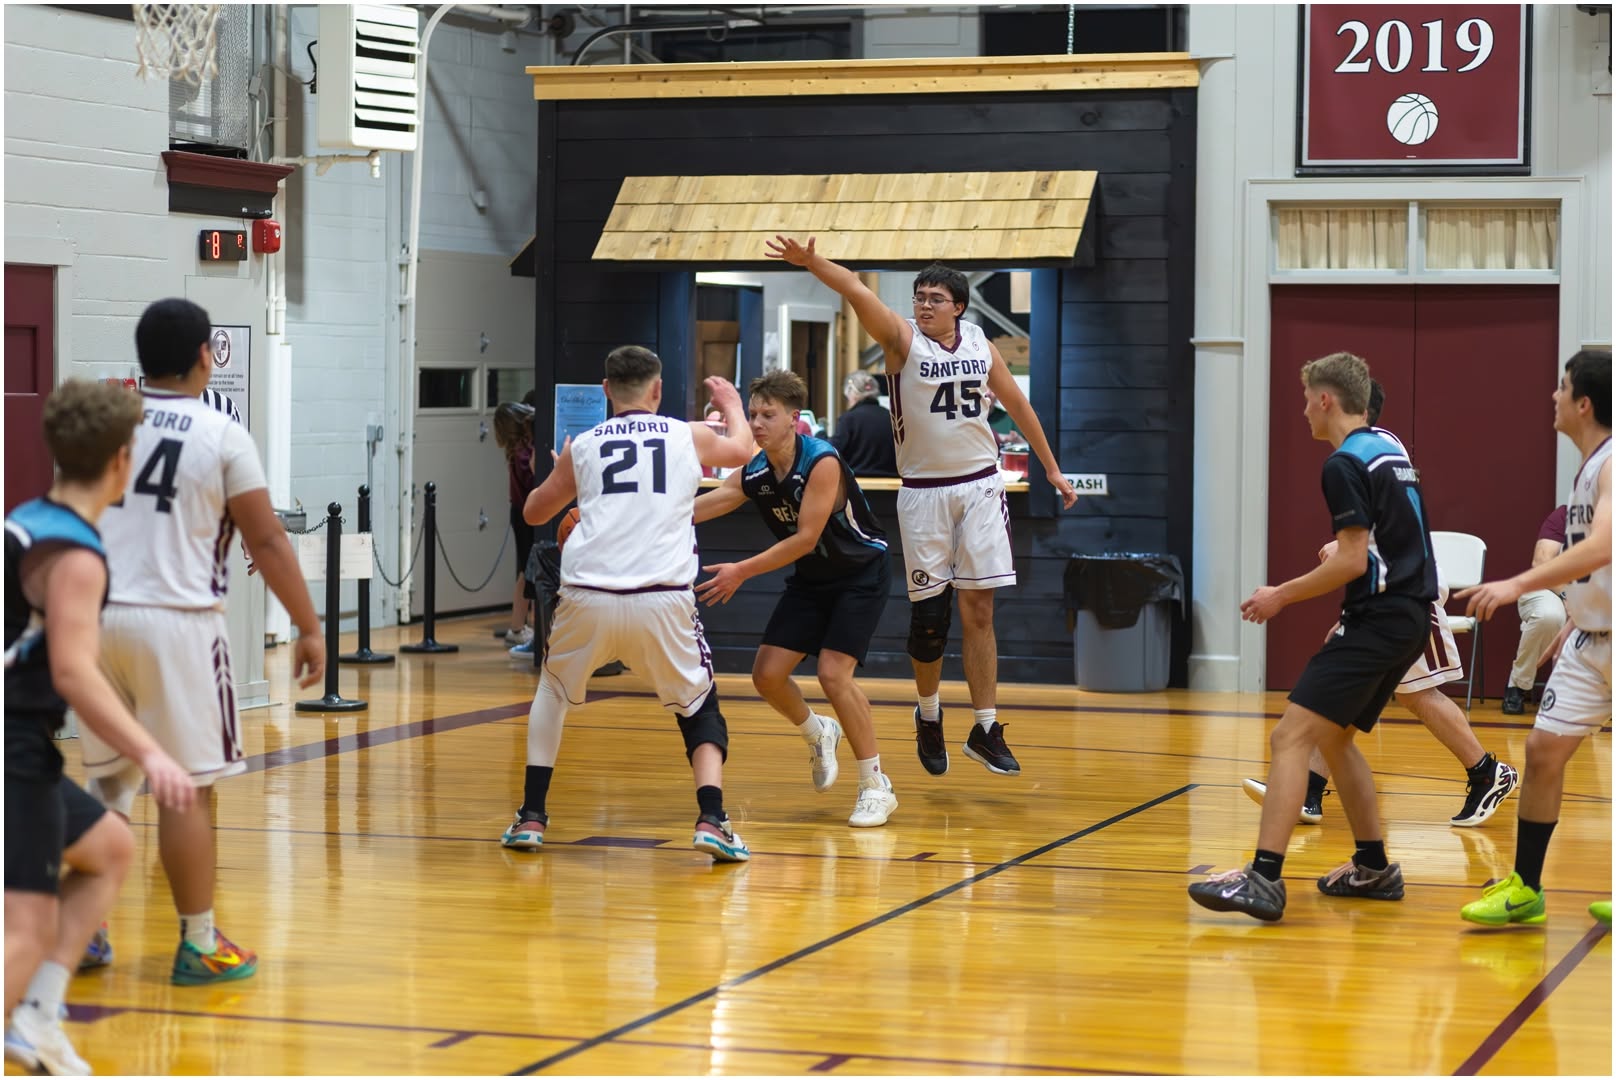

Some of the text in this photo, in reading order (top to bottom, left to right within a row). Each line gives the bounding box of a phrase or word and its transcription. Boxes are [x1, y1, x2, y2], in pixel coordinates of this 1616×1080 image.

[1334, 18, 1495, 74] 2019
[919, 360, 987, 378] SANFORD
[930, 380, 982, 420] 45
[140, 409, 193, 432] FORD
[594, 421, 669, 437] SANFORD
[109, 437, 184, 514] 4
[600, 438, 667, 495] 21
[1067, 478, 1103, 490] RASH
